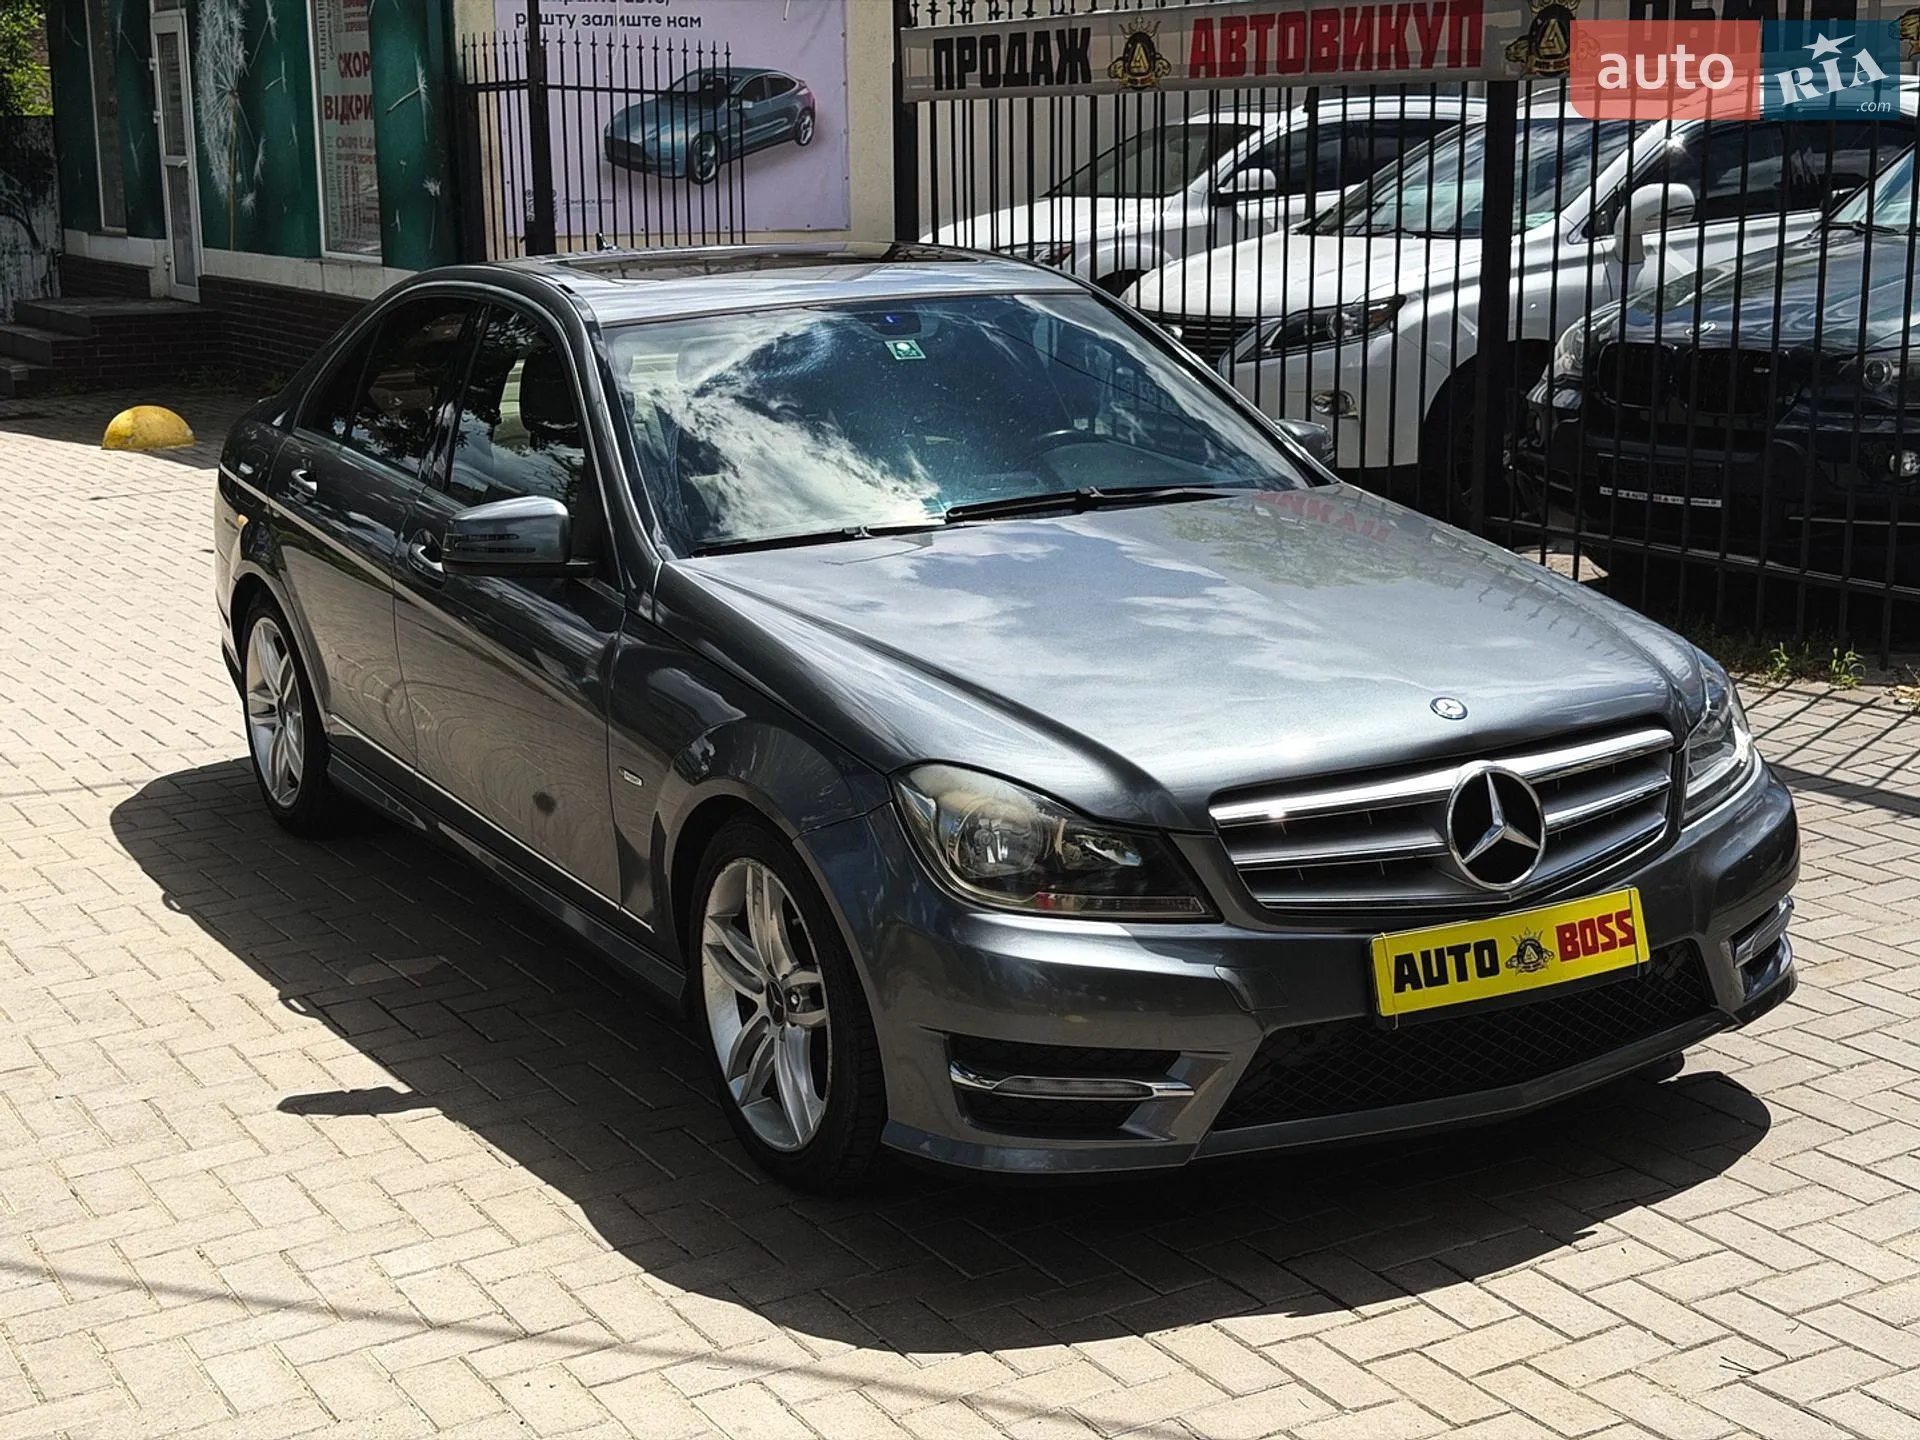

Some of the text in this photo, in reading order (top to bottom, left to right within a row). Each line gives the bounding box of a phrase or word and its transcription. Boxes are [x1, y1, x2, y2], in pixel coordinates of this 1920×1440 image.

[515, 12, 702, 30] ршту залиште нам
[932, 27, 1093, 92] ПРОДАЖ
[1188, 0, 1485, 80] АВТОВИКУП
[1393, 909, 1636, 994] AUTO BOSS
